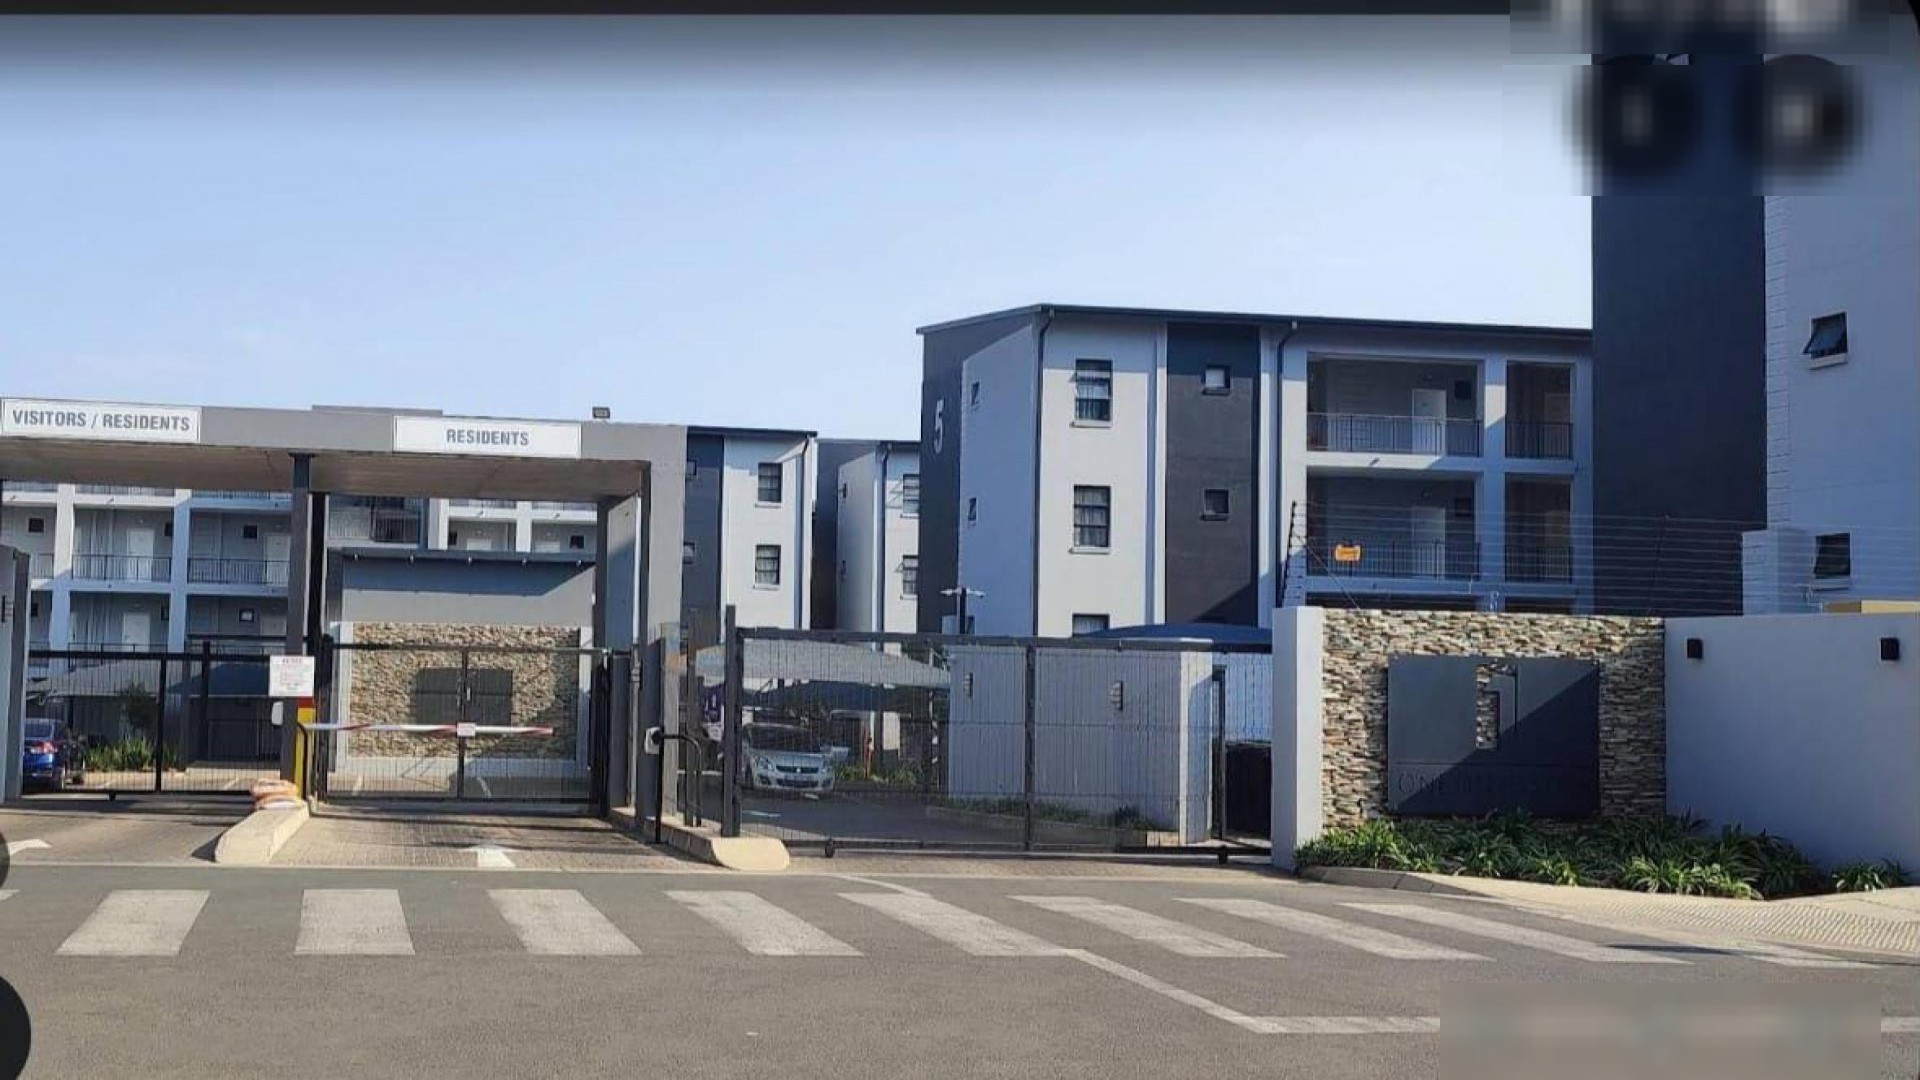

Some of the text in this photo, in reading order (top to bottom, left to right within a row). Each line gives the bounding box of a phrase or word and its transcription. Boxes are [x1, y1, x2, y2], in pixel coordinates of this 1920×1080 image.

[12, 409, 87, 428] VISITORS
[102, 413, 190, 432] RESIDENTS
[934, 399, 944, 454] 5
[446, 428, 530, 446] RESIDENTS
